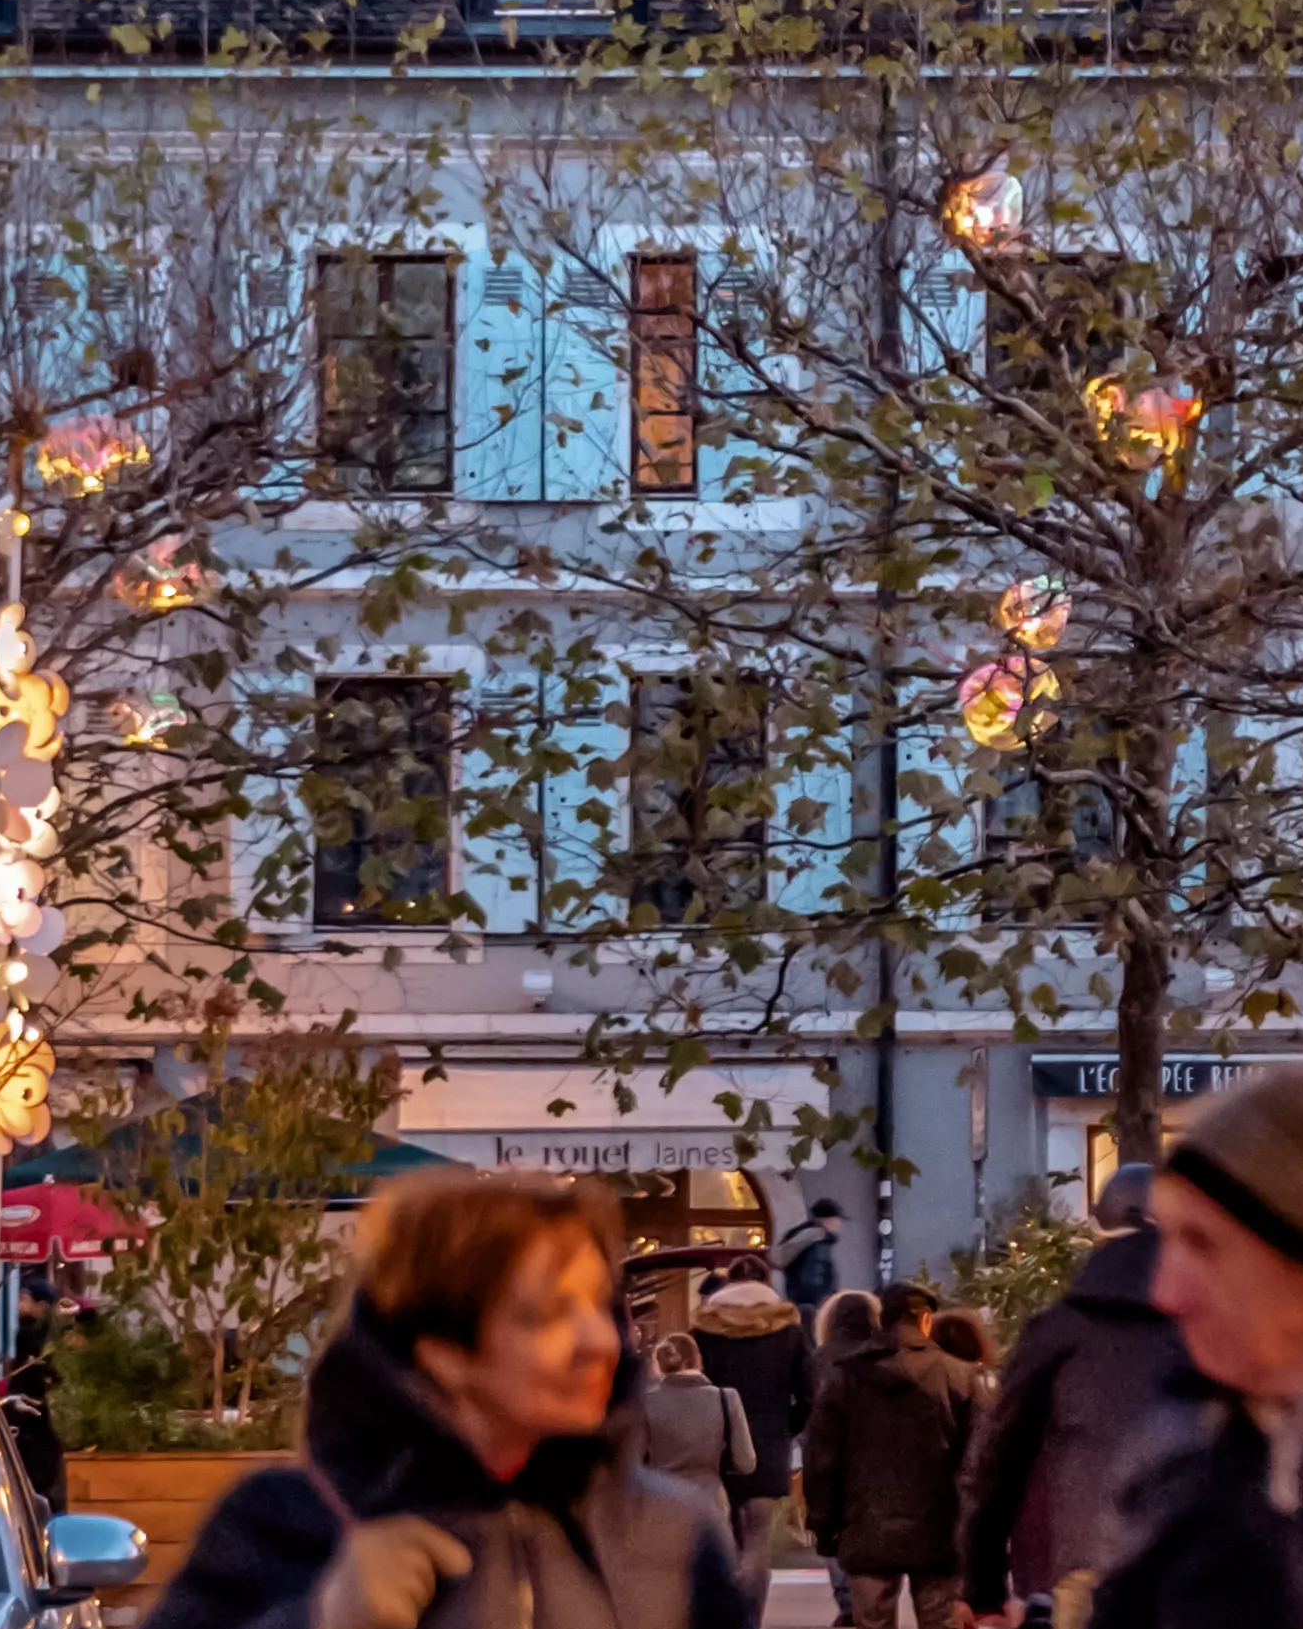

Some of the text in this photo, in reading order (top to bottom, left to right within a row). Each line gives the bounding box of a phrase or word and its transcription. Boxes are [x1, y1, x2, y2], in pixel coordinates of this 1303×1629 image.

[494, 1136, 733, 1166] le rouet laines
